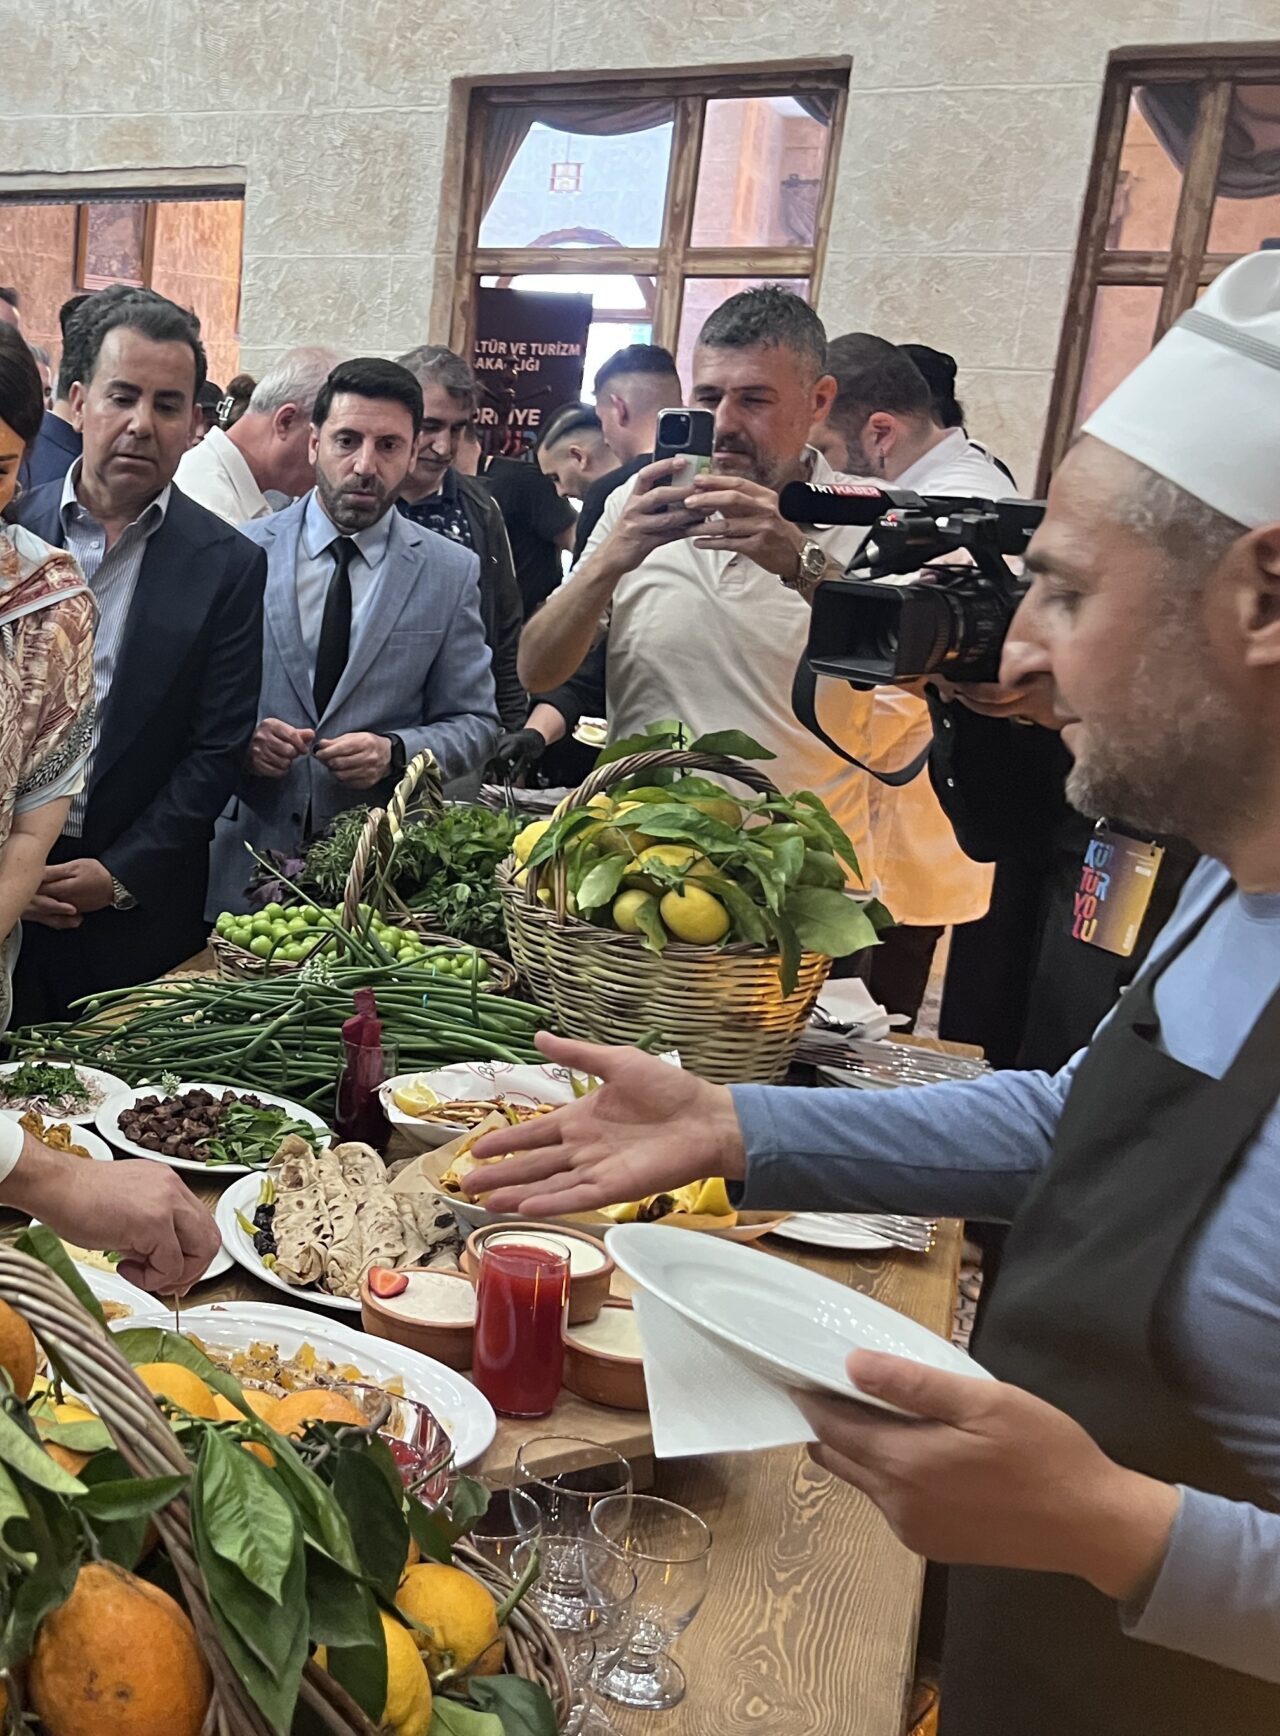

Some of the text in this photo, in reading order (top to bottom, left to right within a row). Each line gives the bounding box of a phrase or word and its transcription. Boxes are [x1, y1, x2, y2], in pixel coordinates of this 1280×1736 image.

[510, 342, 527, 355] VE
[530, 341, 581, 356] TURİZM
[832, 484, 882, 498] HABER
